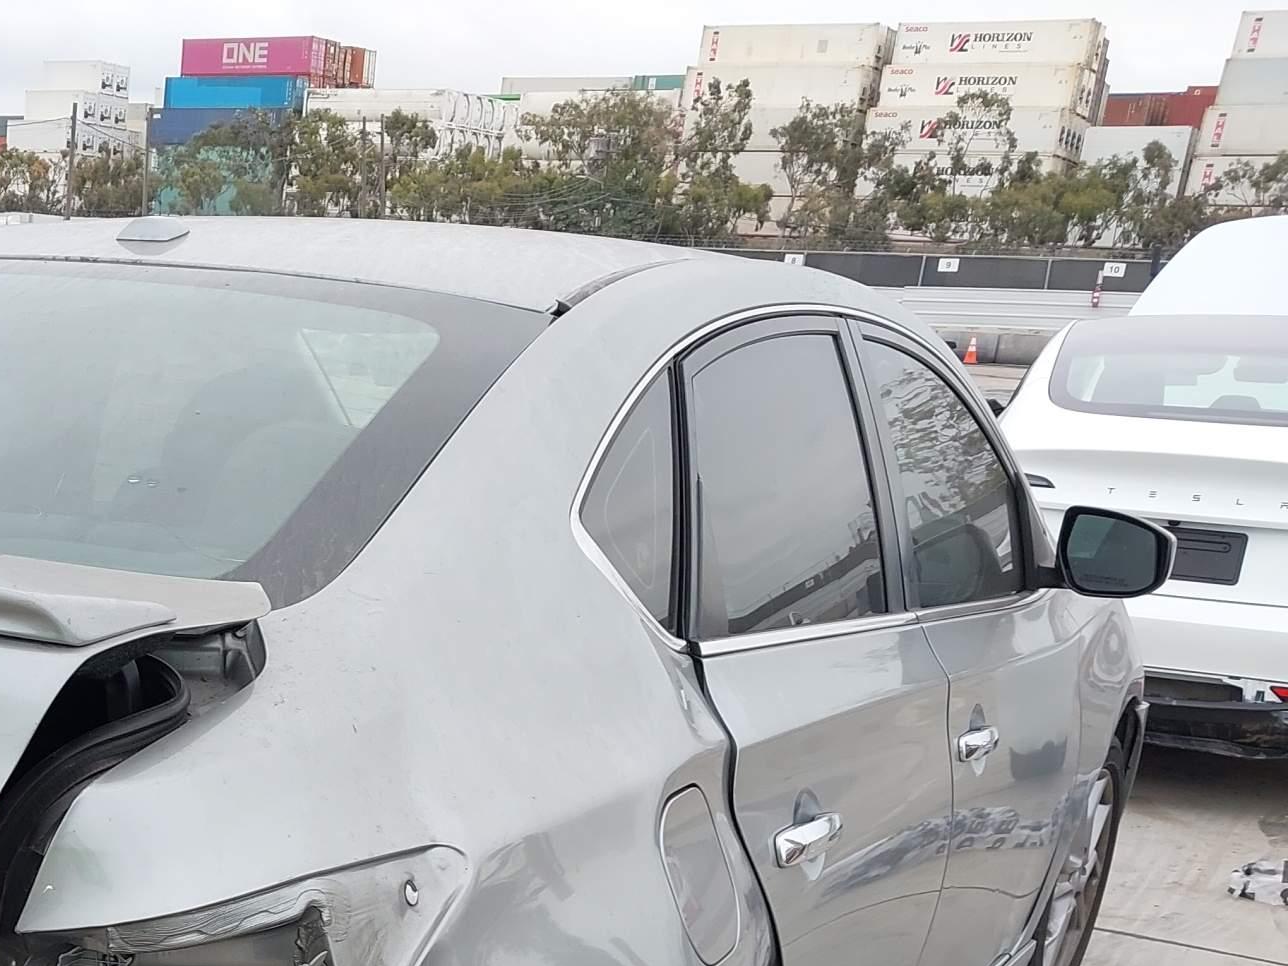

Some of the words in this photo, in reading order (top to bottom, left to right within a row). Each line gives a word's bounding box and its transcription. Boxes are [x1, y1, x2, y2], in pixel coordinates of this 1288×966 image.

[973, 32, 1033, 43] HORIZON
[222, 42, 269, 63] ONE
[958, 76, 1018, 86] HORIZON
[1110, 265, 1120, 274] 10
